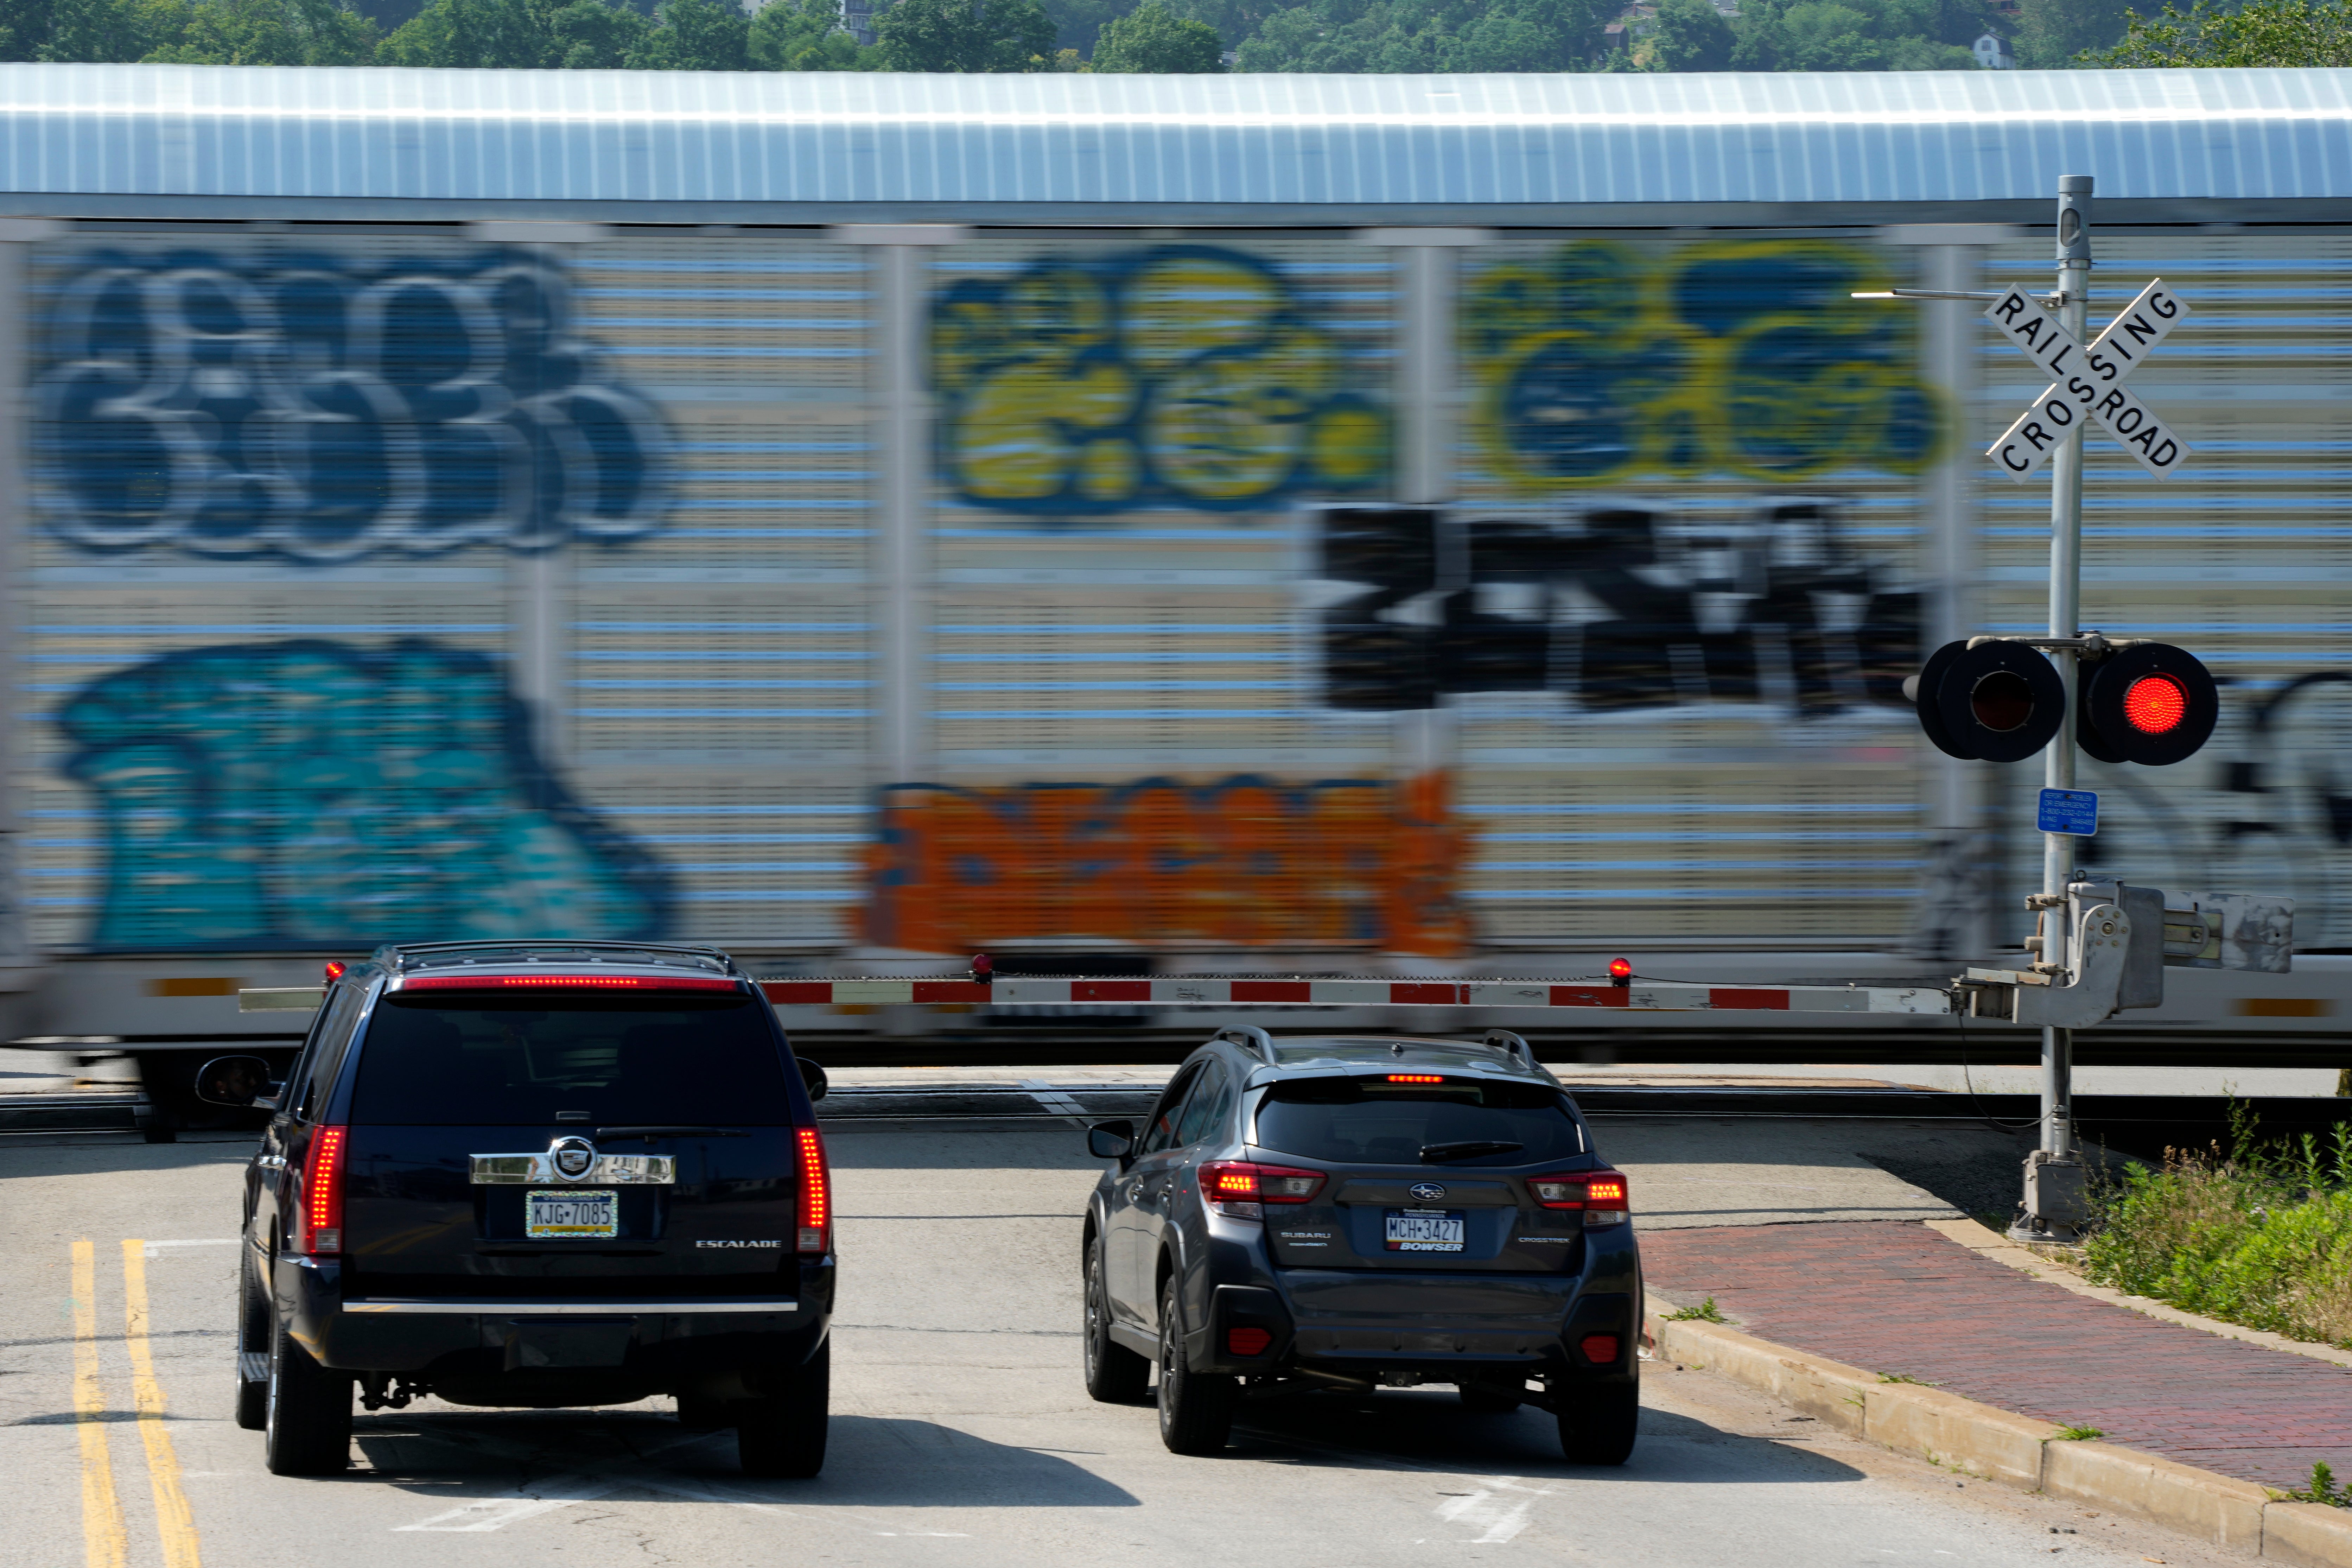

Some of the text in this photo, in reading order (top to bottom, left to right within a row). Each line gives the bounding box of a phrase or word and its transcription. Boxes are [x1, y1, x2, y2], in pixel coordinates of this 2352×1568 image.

[1995, 293, 2177, 466] RAIL ROAD
[2003, 292, 2176, 471] CROSSING
[2054, 800, 2092, 809] EMERGENCY
[1399, 1242, 1463, 1251] BOWSER
